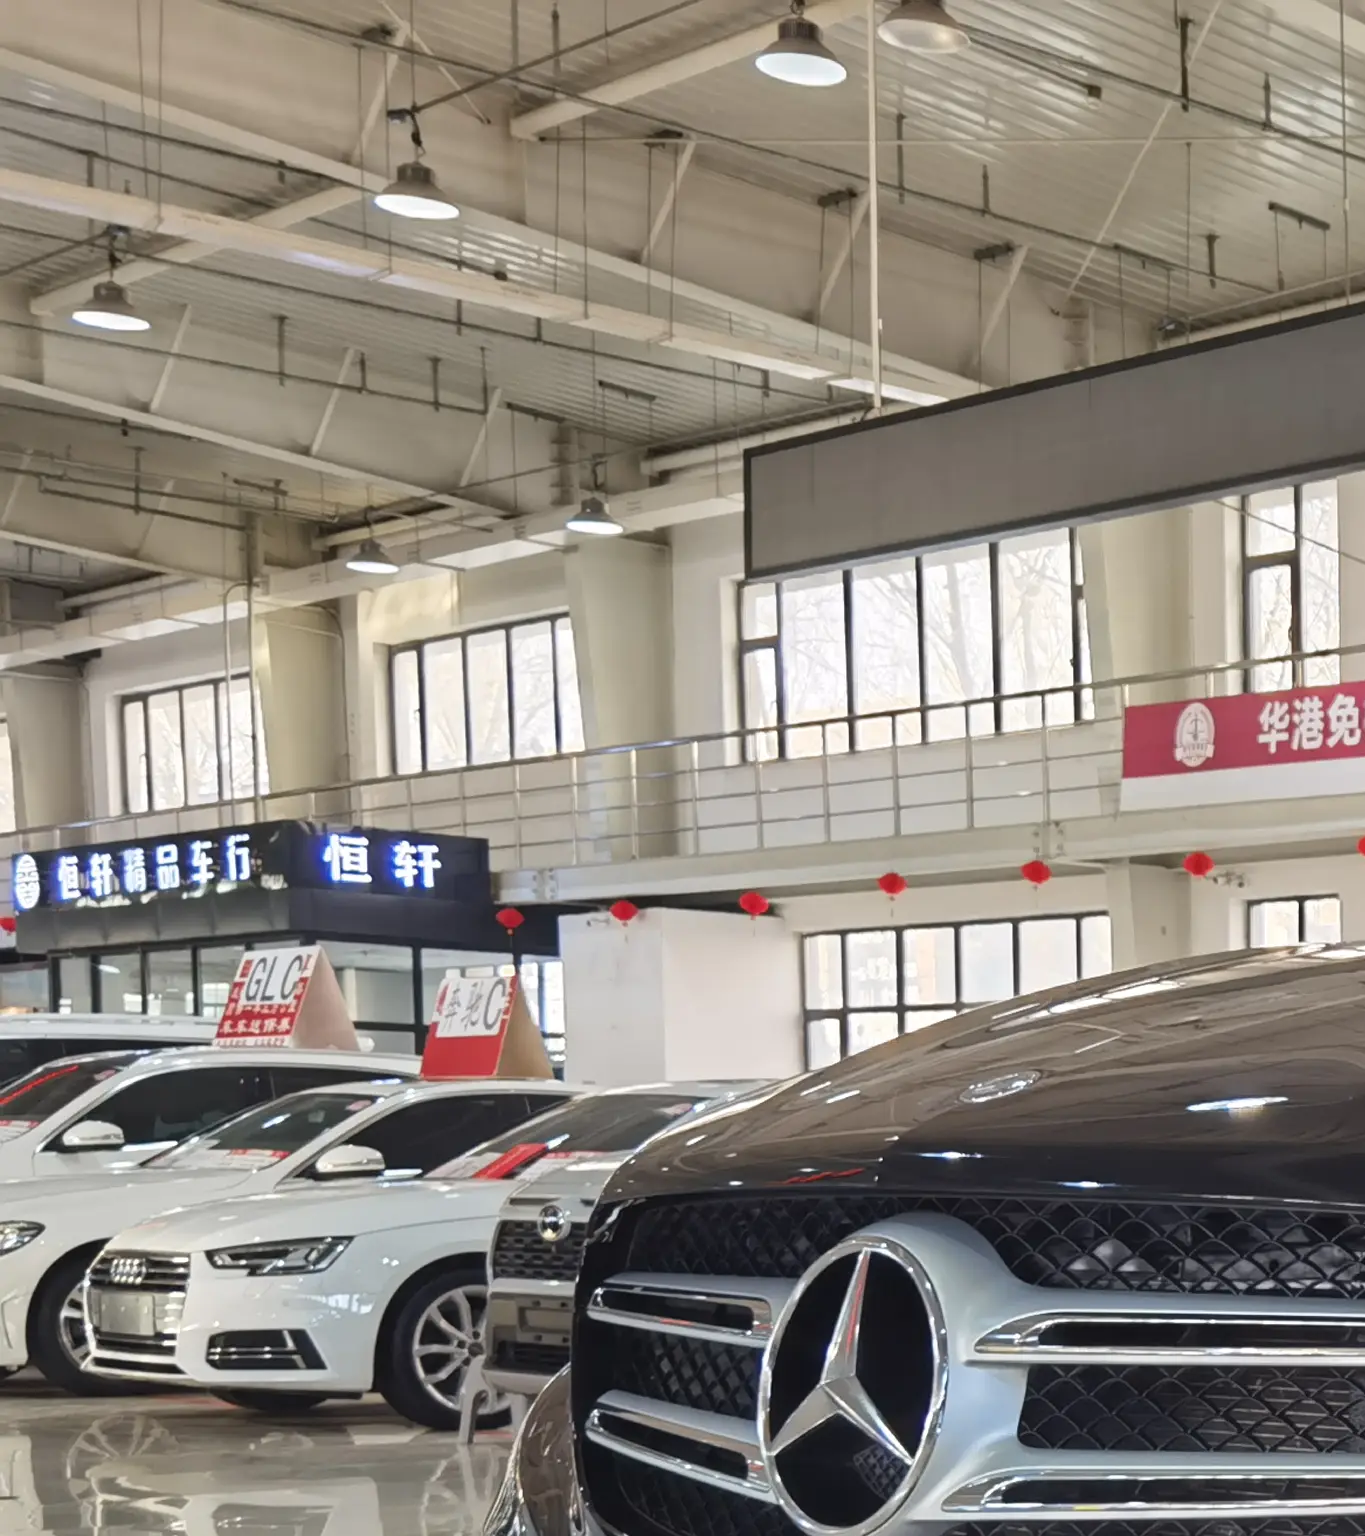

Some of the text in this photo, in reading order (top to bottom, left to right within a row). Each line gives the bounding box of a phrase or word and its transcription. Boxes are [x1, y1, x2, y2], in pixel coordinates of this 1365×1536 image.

[57, 833, 252, 901] 恒轩精品车行
[245, 953, 304, 1002] GLC
